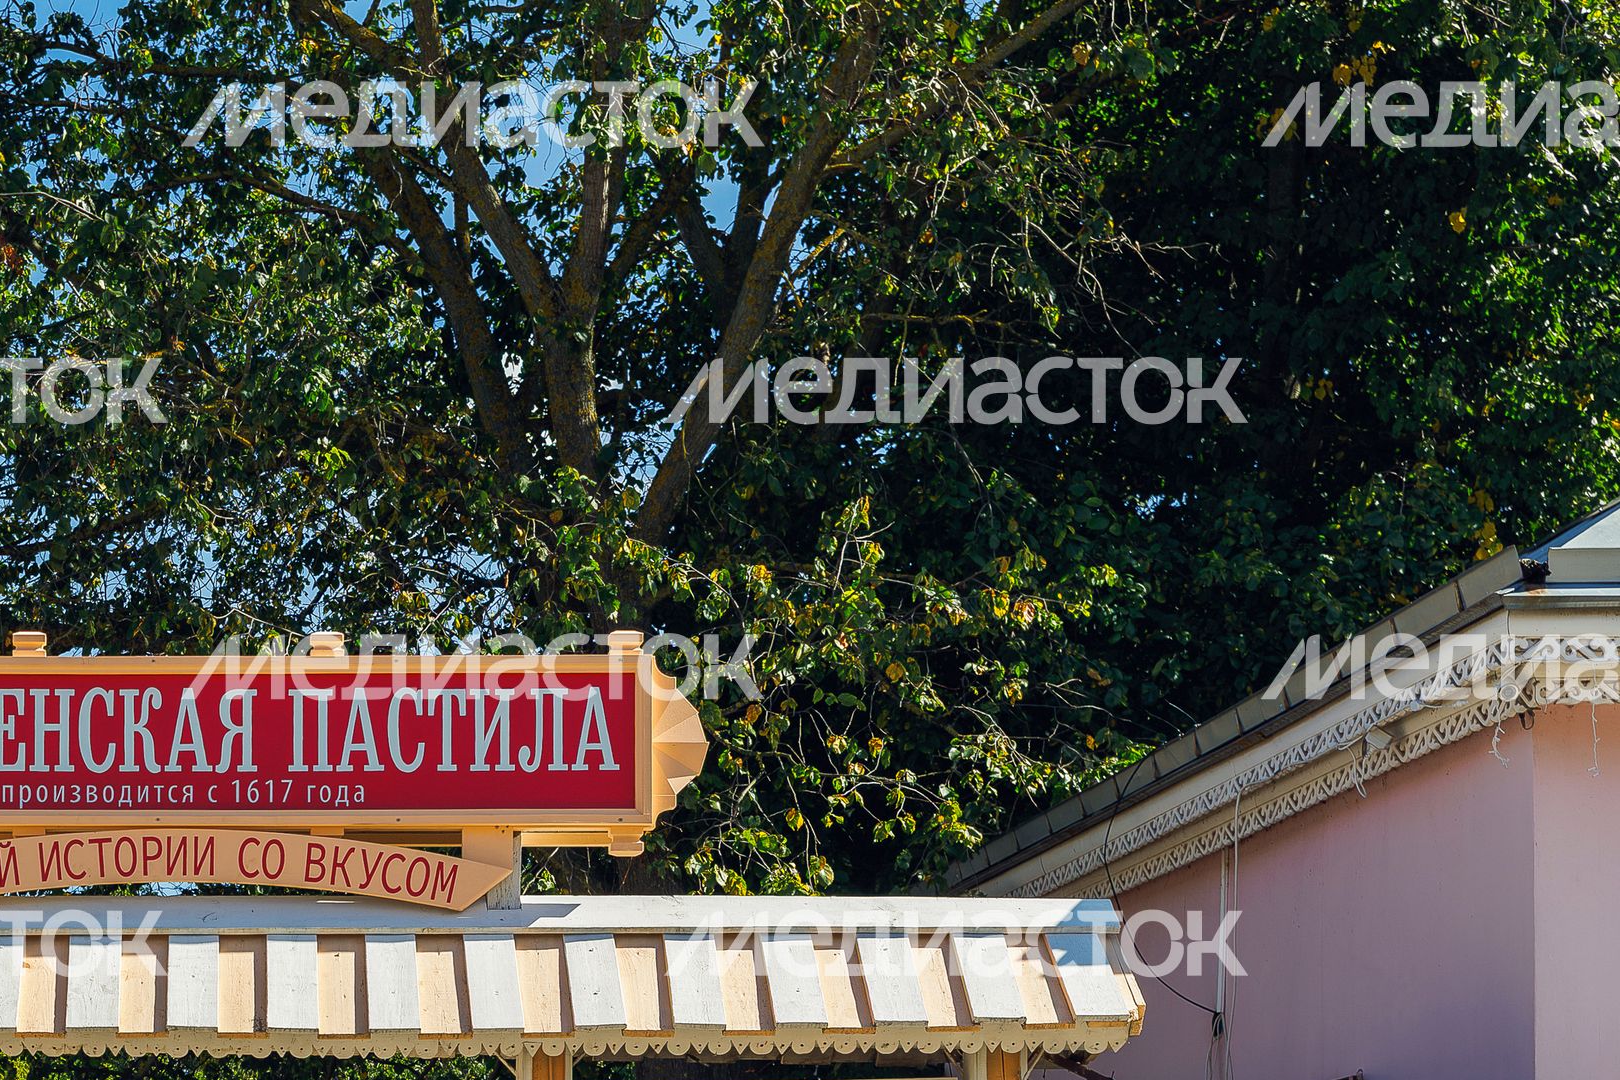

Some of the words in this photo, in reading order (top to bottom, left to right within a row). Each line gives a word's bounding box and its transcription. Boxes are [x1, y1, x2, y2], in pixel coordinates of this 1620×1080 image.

[287, 684, 622, 774] ПАСТИЛА
[0, 782, 196, 808] производится
[207, 787, 219, 804] с
[230, 779, 294, 806] 1617
[306, 784, 366, 807] года
[36, 833, 216, 885] ИСТОРИИ
[237, 836, 284, 881] СО
[302, 842, 460, 908] ВКУСОМ
